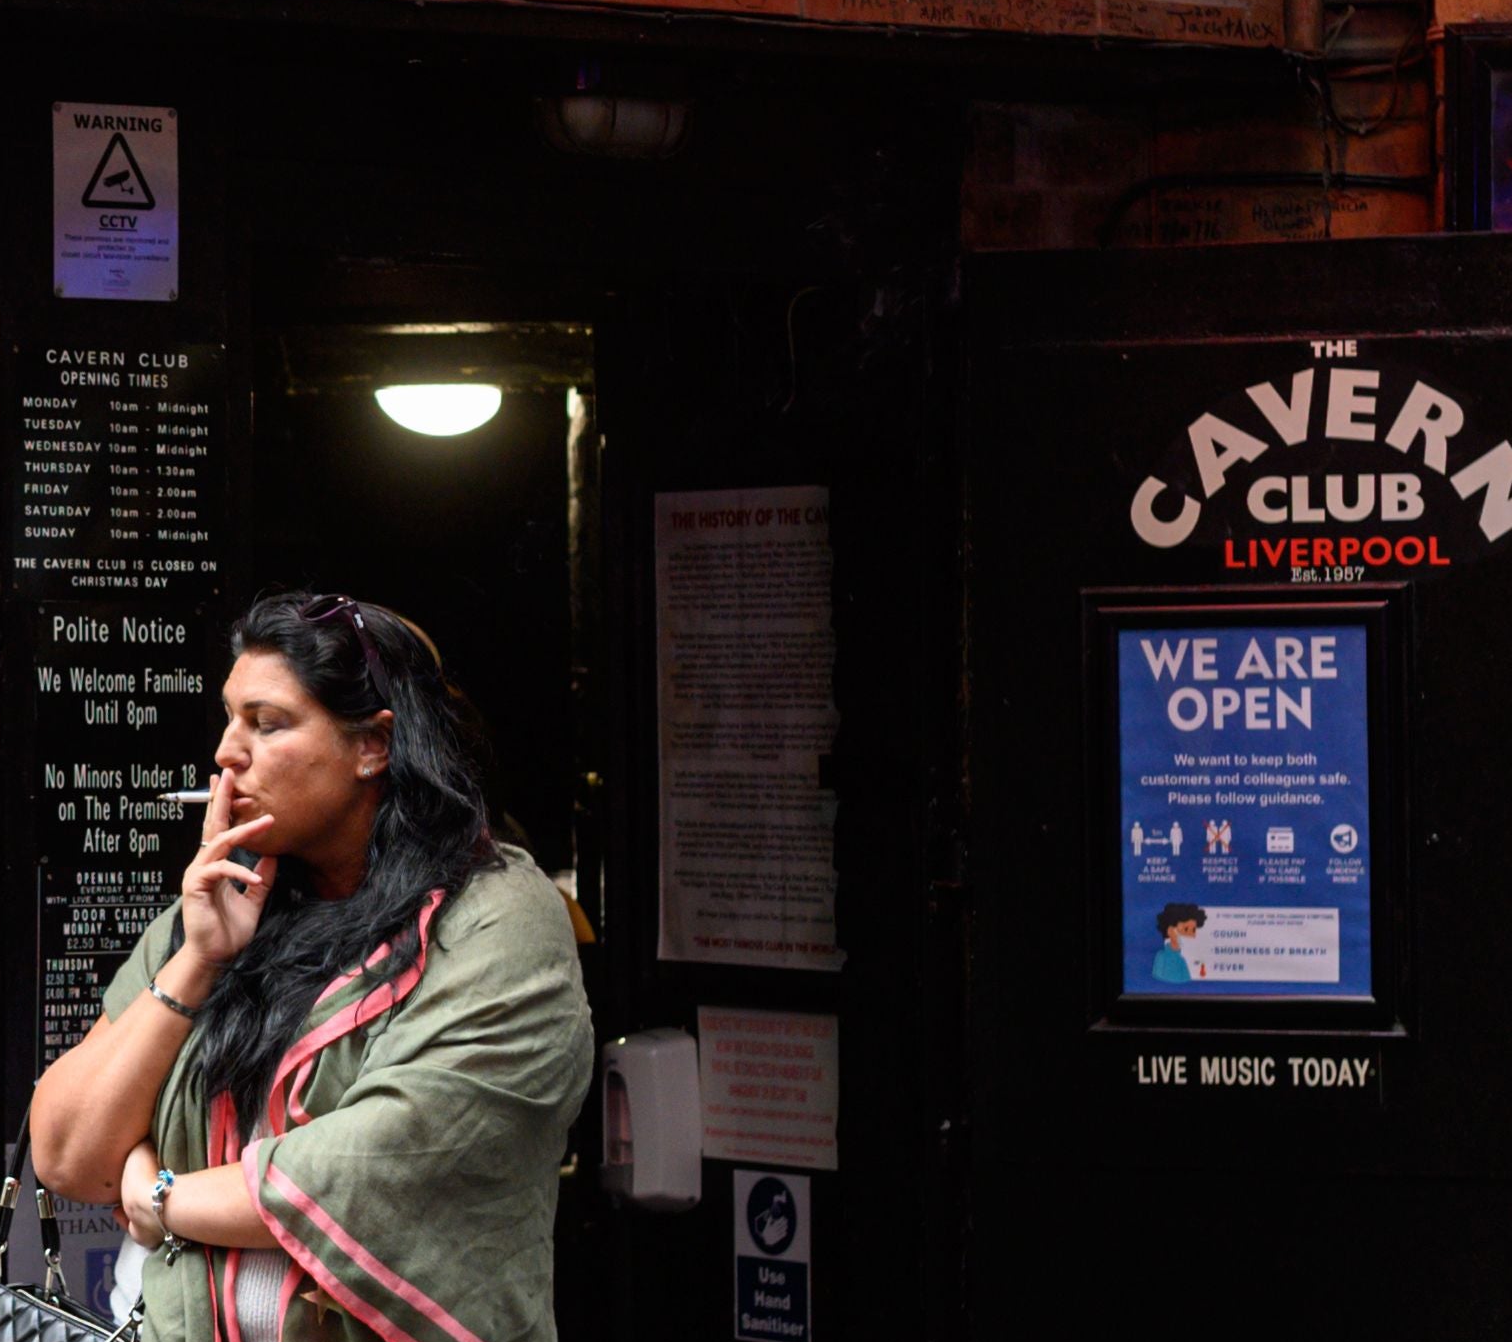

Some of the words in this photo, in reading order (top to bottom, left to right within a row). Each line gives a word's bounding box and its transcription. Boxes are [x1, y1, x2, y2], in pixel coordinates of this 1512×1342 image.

[74, 114, 162, 133] WARNING
[99, 215, 138, 229] CCTV
[1311, 339, 1358, 358] THE
[46, 349, 125, 366] CAVERN
[139, 353, 189, 369] CLUB
[61, 371, 120, 387] OPENING
[128, 373, 169, 389] TIMES
[23, 397, 77, 409] MONDAY
[24, 418, 81, 430] TUESDAY
[24, 440, 101, 452] WEDNESDAY
[25, 462, 91, 474] THURSDAY
[24, 484, 69, 495] FRIDAY
[1246, 473, 1425, 523] CLUB
[25, 505, 91, 516] SATURDAY
[25, 527, 76, 538] SUNDAY
[1224, 535, 1451, 569] LIVERPOOL
[53, 616, 109, 643] Polite
[123, 617, 186, 644] Notice
[1140, 638, 1219, 682] WE
[1234, 636, 1338, 679] ARE
[38, 667, 61, 693] We
[70, 667, 136, 693] Welcome
[144, 667, 203, 694] Families
[85, 700, 119, 725] Until
[127, 700, 157, 731] 8pm
[1167, 686, 1312, 732] OPEN
[45, 763, 65, 789] No
[74, 763, 122, 789] Minors
[131, 763, 174, 789] Under
[182, 763, 196, 789] 18
[58, 802, 76, 821] on
[84, 795, 111, 821] The
[120, 795, 184, 821] Premises
[83, 827, 120, 853] After
[129, 827, 160, 858] 8pm
[1137, 1055, 1187, 1085] LIVE
[1200, 1056, 1276, 1086] MUSIC
[1288, 1057, 1370, 1087] TODAY
[758, 1267, 785, 1285] Use
[754, 1291, 791, 1310] Hand
[741, 1313, 804, 1337] Sanitiser
